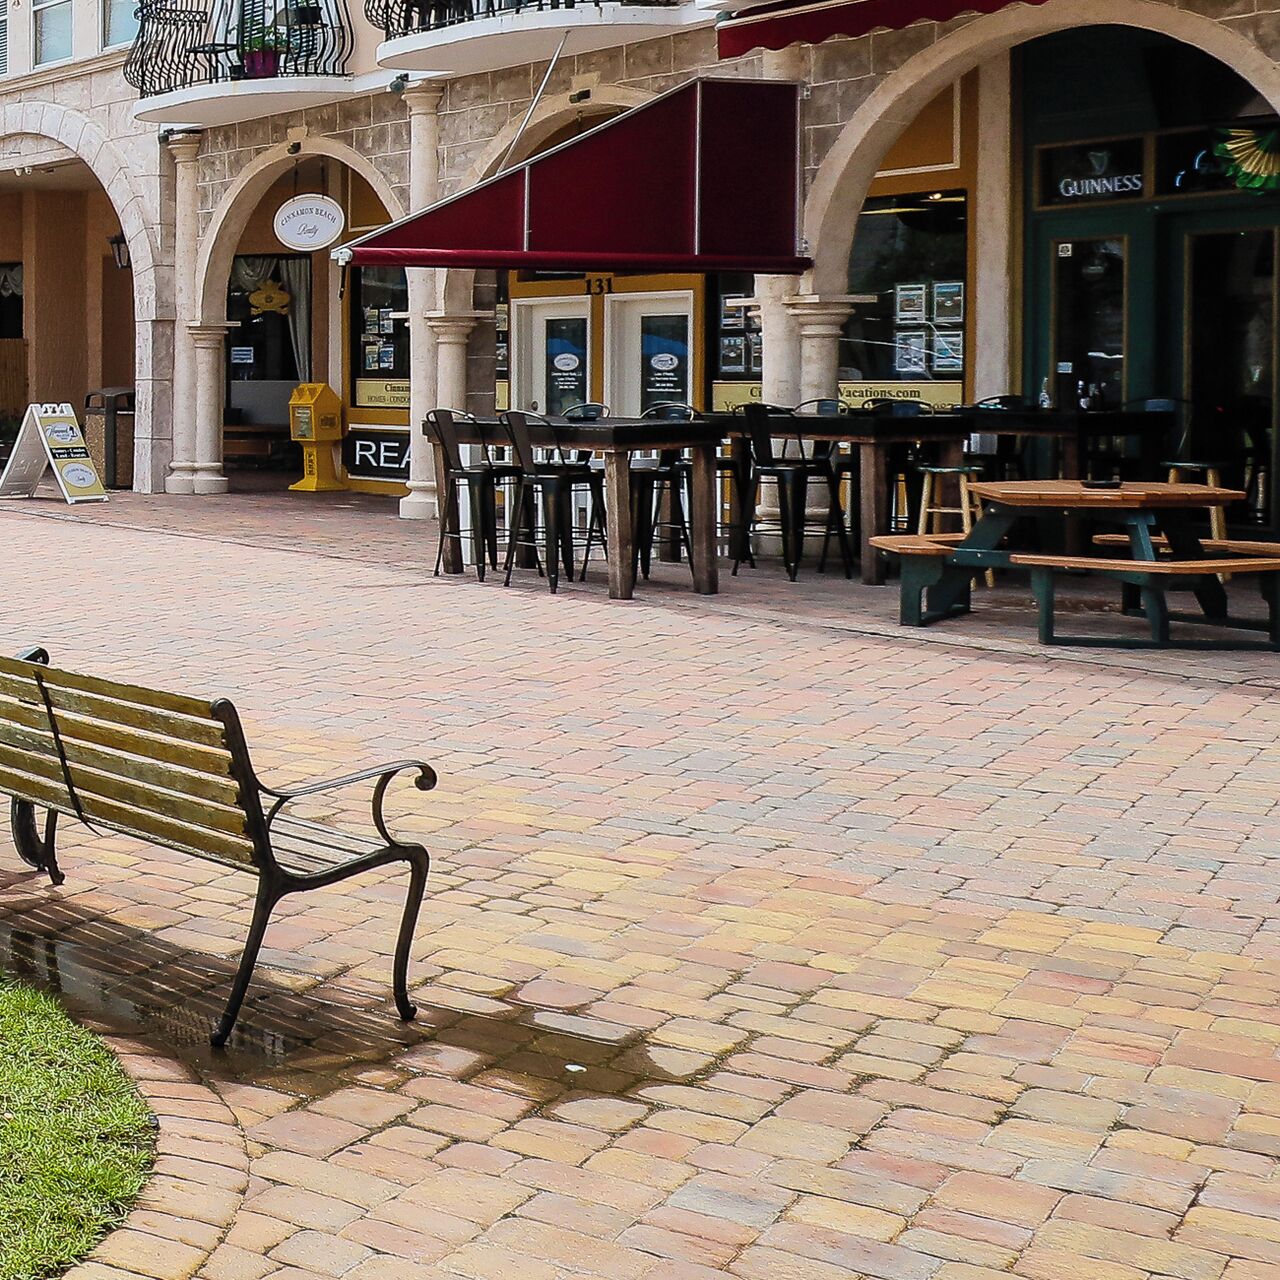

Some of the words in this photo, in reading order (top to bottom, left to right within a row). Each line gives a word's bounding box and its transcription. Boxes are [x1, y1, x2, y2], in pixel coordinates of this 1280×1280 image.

[1059, 174, 1142, 197] GUINNESS
[281, 207, 314, 226] CINNAMON
[315, 207, 337, 224] BEACH
[584, 277, 614, 295] 131
[839, 386, 921, 399] Vacations.com
